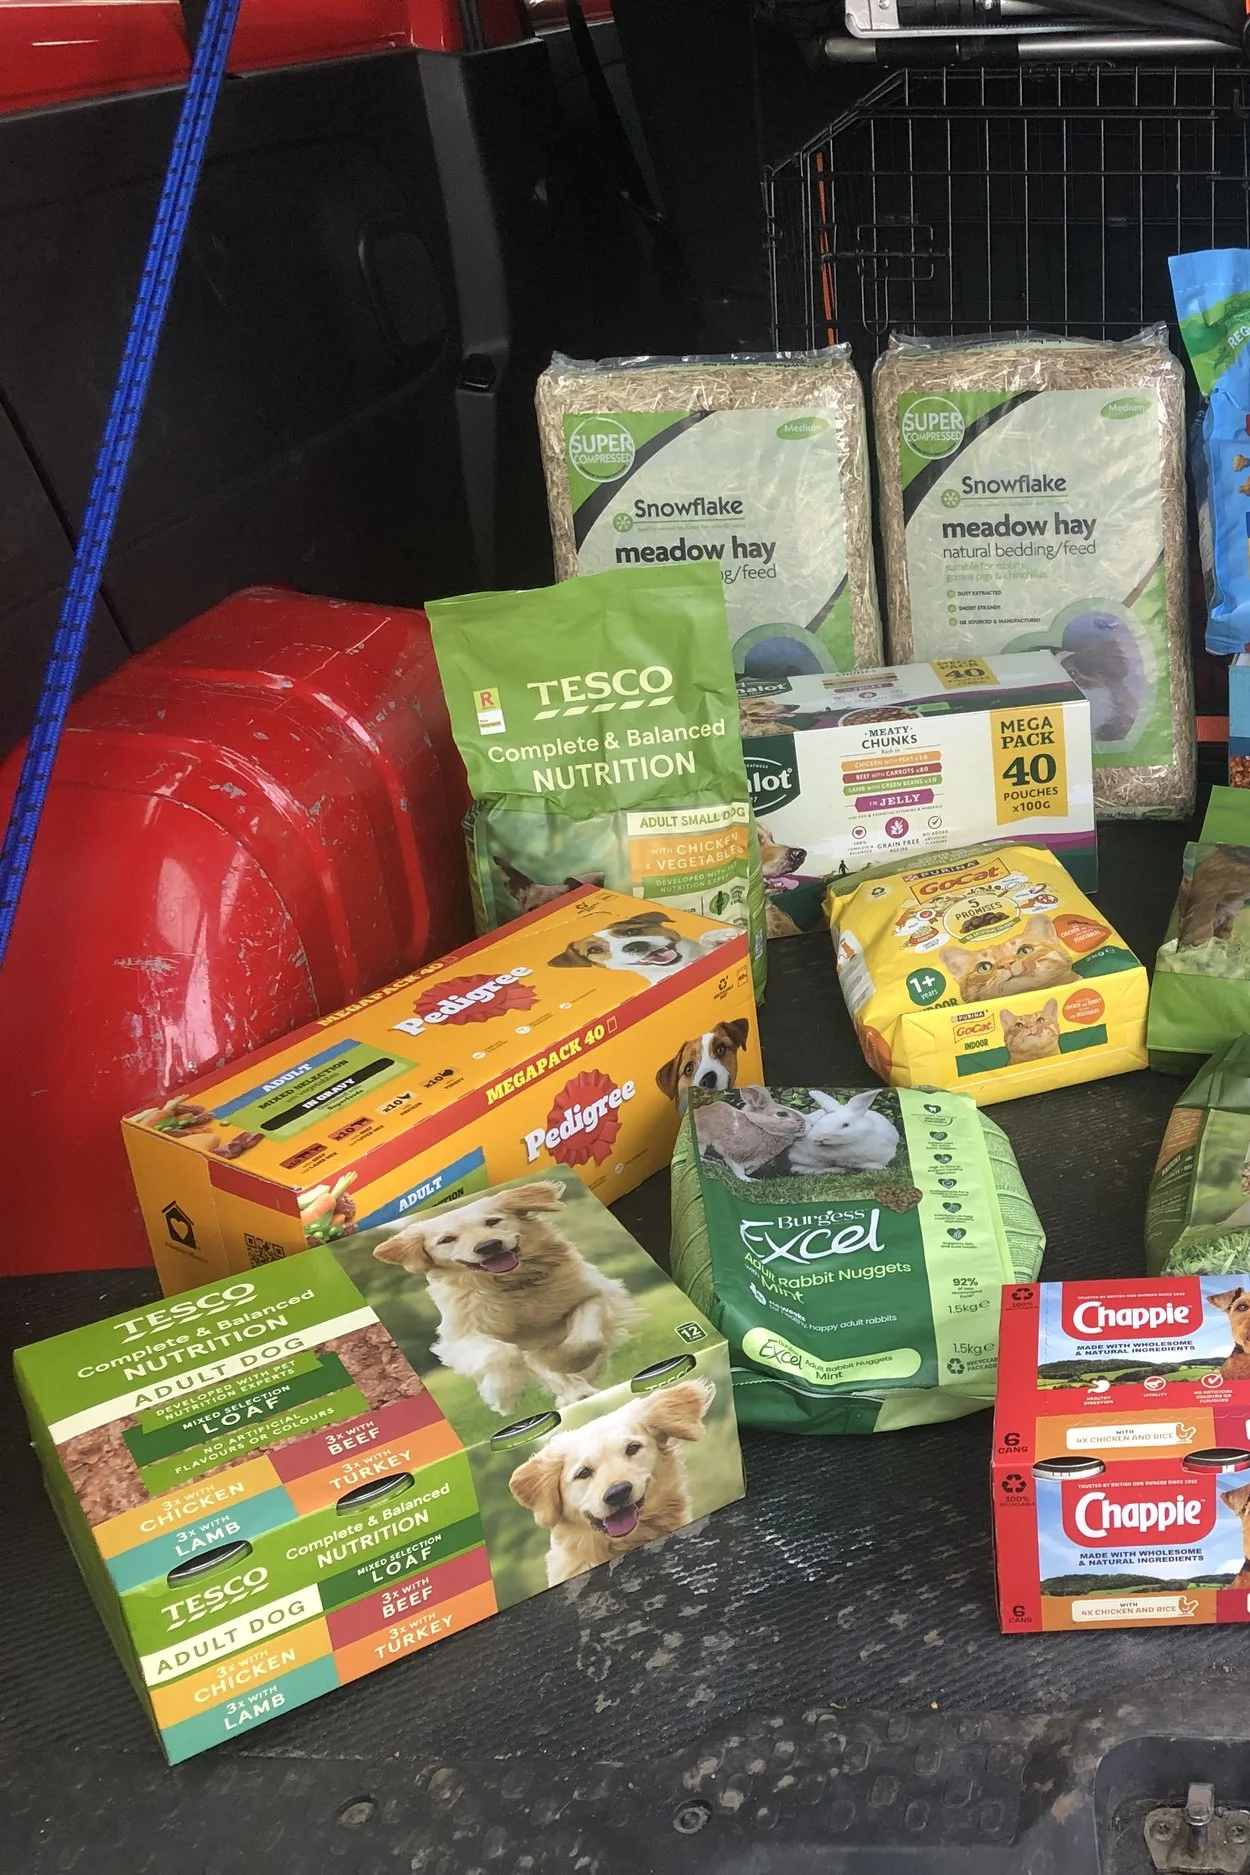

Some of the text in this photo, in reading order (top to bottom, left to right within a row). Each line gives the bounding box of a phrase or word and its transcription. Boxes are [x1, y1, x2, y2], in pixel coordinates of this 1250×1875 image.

[904, 412, 964, 431] SUPER
[570, 433, 634, 454] SUPER
[906, 430, 962, 442] COMPRESSED
[573, 452, 633, 465] COMPRESSED
[962, 474, 1067, 494] Snowflake
[634, 498, 744, 518] Snowflake
[942, 512, 1097, 540] meadow hay
[616, 536, 777, 565] meadow hay
[943, 540, 1096, 559] natural bedding/feed
[527, 665, 673, 706] TESCO
[868, 725, 910, 737] MEATY
[1000, 715, 1052, 734] MEGA
[487, 718, 725, 763] Complete & Balanced
[861, 734, 917, 750] CHUNKS
[1001, 731, 1055, 749] PACK
[532, 750, 696, 793] NUTRITION
[1002, 753, 1057, 786] 40
[879, 792, 920, 807] JELLY
[1003, 787, 1059, 801] POUCHES
[1012, 800, 1051, 814] x100G
[640, 807, 746, 829] ADULT SMALL DOG
[877, 838, 920, 850] GRAIN FREE
[919, 866, 1000, 896] GoCat
[955, 902, 1003, 921] PROMISES
[909, 974, 937, 994] 1+
[920, 988, 938, 1000] years
[392, 964, 534, 1038] Pedigree
[956, 1023, 993, 1037] GoCat
[959, 1011, 984, 1021] PURINA
[964, 1039, 989, 1050] INDOOR
[261, 1063, 313, 1093] ADULT
[485, 1023, 606, 1105] MEGAPACK 40
[301, 1077, 356, 1110] IN GRAVY
[523, 1080, 637, 1163] Pedigree
[398, 1176, 445, 1212] ADULT
[778, 1208, 866, 1229] Burgess
[740, 1208, 886, 1264] Excel
[778, 1261, 912, 1289] Rabbit Nuggets
[952, 1278, 979, 1287] 92%
[761, 1279, 805, 1304] Mint
[113, 1283, 255, 1340] TESCO
[948, 1302, 978, 1315] 1.5kg
[1072, 1299, 1190, 1334] Chappie
[77, 1289, 315, 1380] Complete & Balanced
[124, 1314, 290, 1381] NUTRITION
[953, 1342, 982, 1356] 1.5kg
[135, 1337, 305, 1408] ADULT DOG
[203, 1395, 281, 1435] LOAF
[327, 1427, 380, 1457] BEEF
[329, 1450, 413, 1490] TURKEY
[140, 1481, 245, 1534] CHICKEN
[1074, 1491, 1202, 1538] Chappie
[175, 1521, 242, 1558] LAMB
[317, 1509, 430, 1569] NUTRITION
[371, 1547, 433, 1583] LOAF
[1080, 1548, 1203, 1560] MADE WITH WHOLESOME
[1088, 1557, 1135, 1566] NATURAL
[1137, 1555, 1204, 1565] INGREDIENTS
[161, 1566, 268, 1624] TESCO
[381, 1586, 434, 1619] BEEF
[1008, 1616, 1033, 1624] CANS
[1012, 1605, 1026, 1617] 6
[157, 1600, 305, 1675] ADULT DOG
[375, 1614, 454, 1659] TURKEY
[193, 1648, 296, 1704] CHICKEN
[224, 1693, 286, 1731] LAMB
